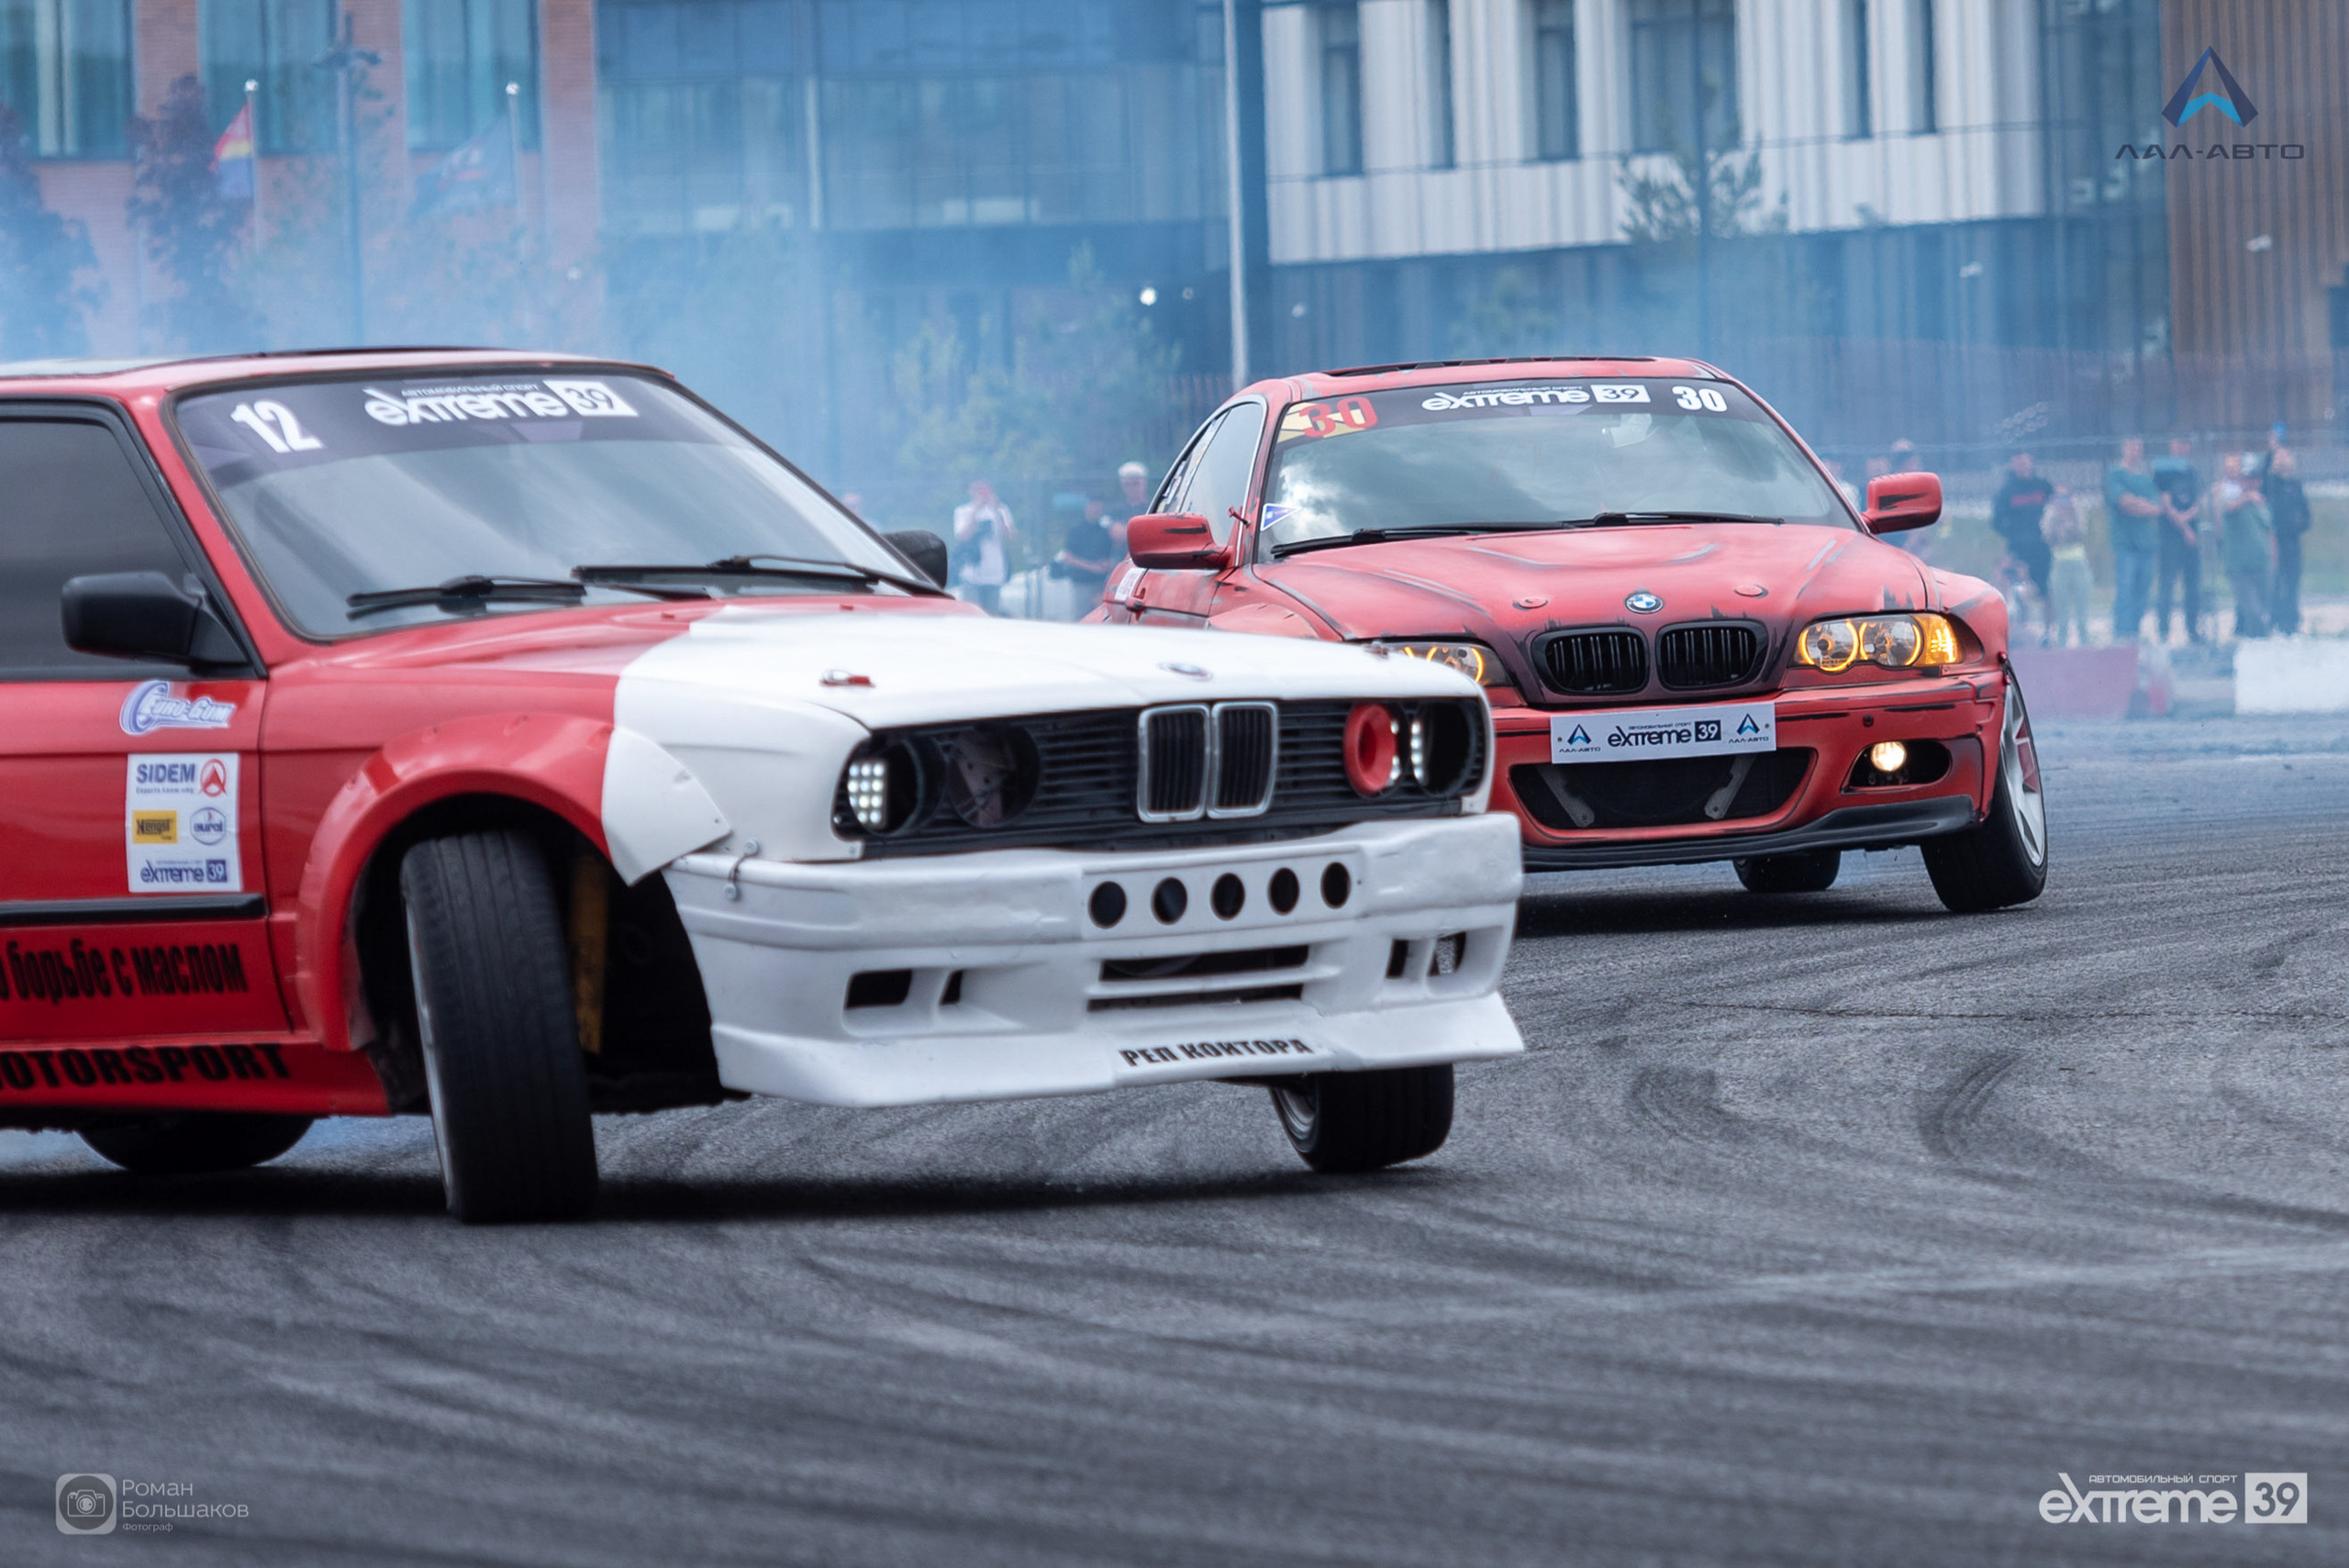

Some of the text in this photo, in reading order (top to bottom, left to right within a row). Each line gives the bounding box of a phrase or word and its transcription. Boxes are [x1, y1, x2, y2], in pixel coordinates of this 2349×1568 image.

[564, 385, 615, 411] 39
[1602, 387, 1642, 401] 39
[1670, 385, 1728, 413] 30
[230, 399, 324, 453] 12
[1298, 396, 1377, 439] 30
[1698, 723, 1719, 740] 39
[136, 763, 195, 784] SIDEM
[208, 862, 224, 881] 39
[6, 938, 111, 1005] борьбе
[111, 947, 133, 996] с
[130, 942, 249, 996] маслом
[0, 1042, 291, 1090] OTORSPORT
